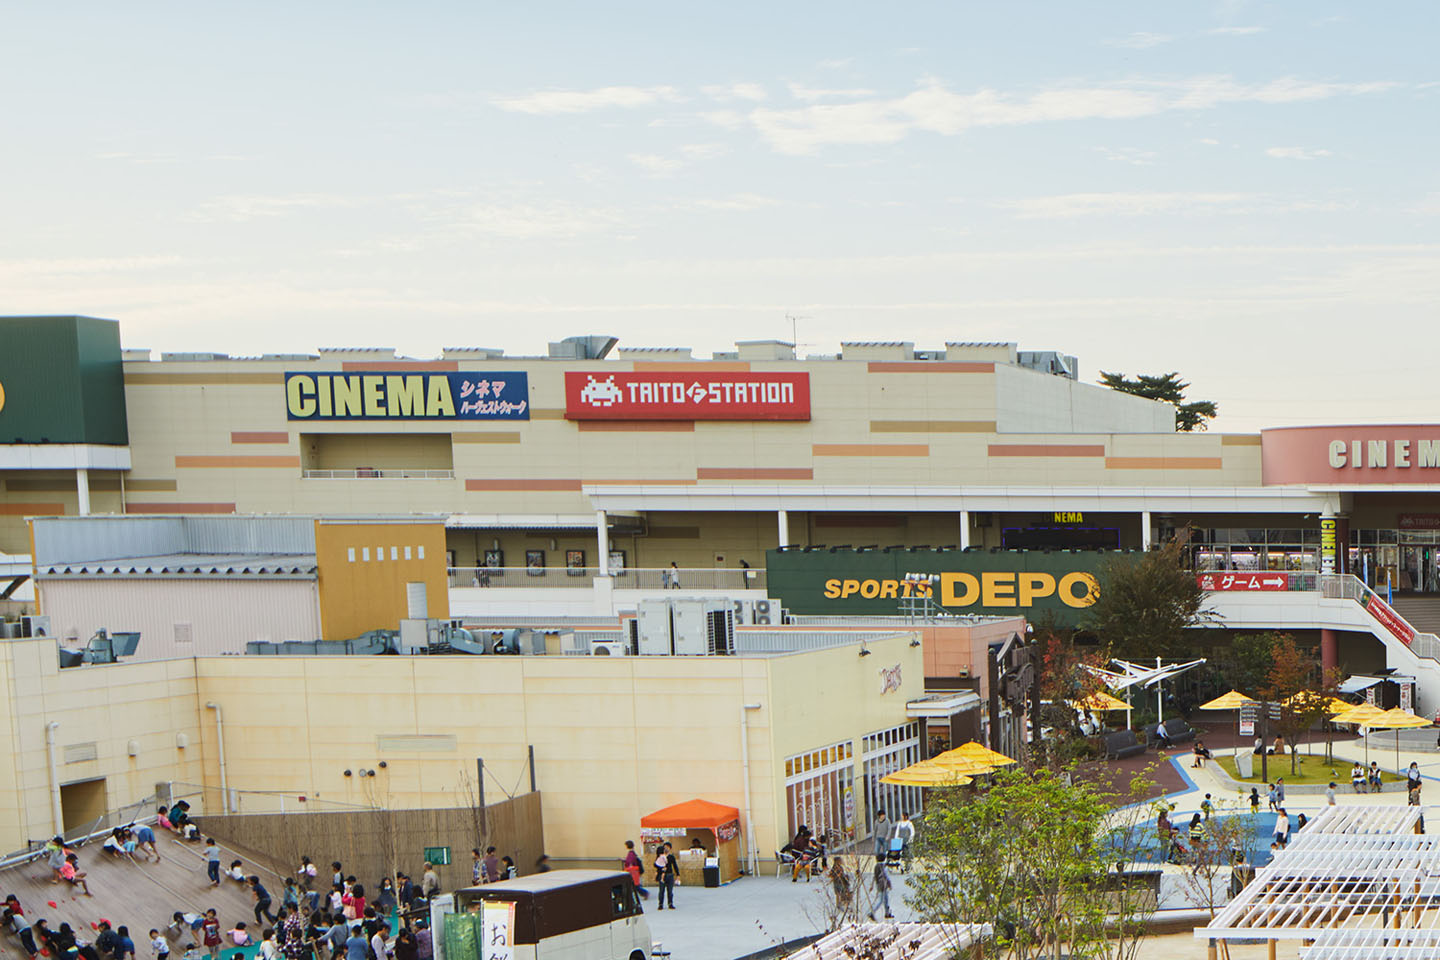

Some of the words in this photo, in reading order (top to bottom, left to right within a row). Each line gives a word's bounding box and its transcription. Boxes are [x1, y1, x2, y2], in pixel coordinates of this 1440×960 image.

[287, 374, 456, 418] CINEMA
[460, 380, 506, 399] シネマ
[626, 382, 685, 404] TAITO
[708, 382, 794, 404] STATION
[940, 571, 1101, 609] DEPO
[1221, 575, 1261, 589] ゲーム
